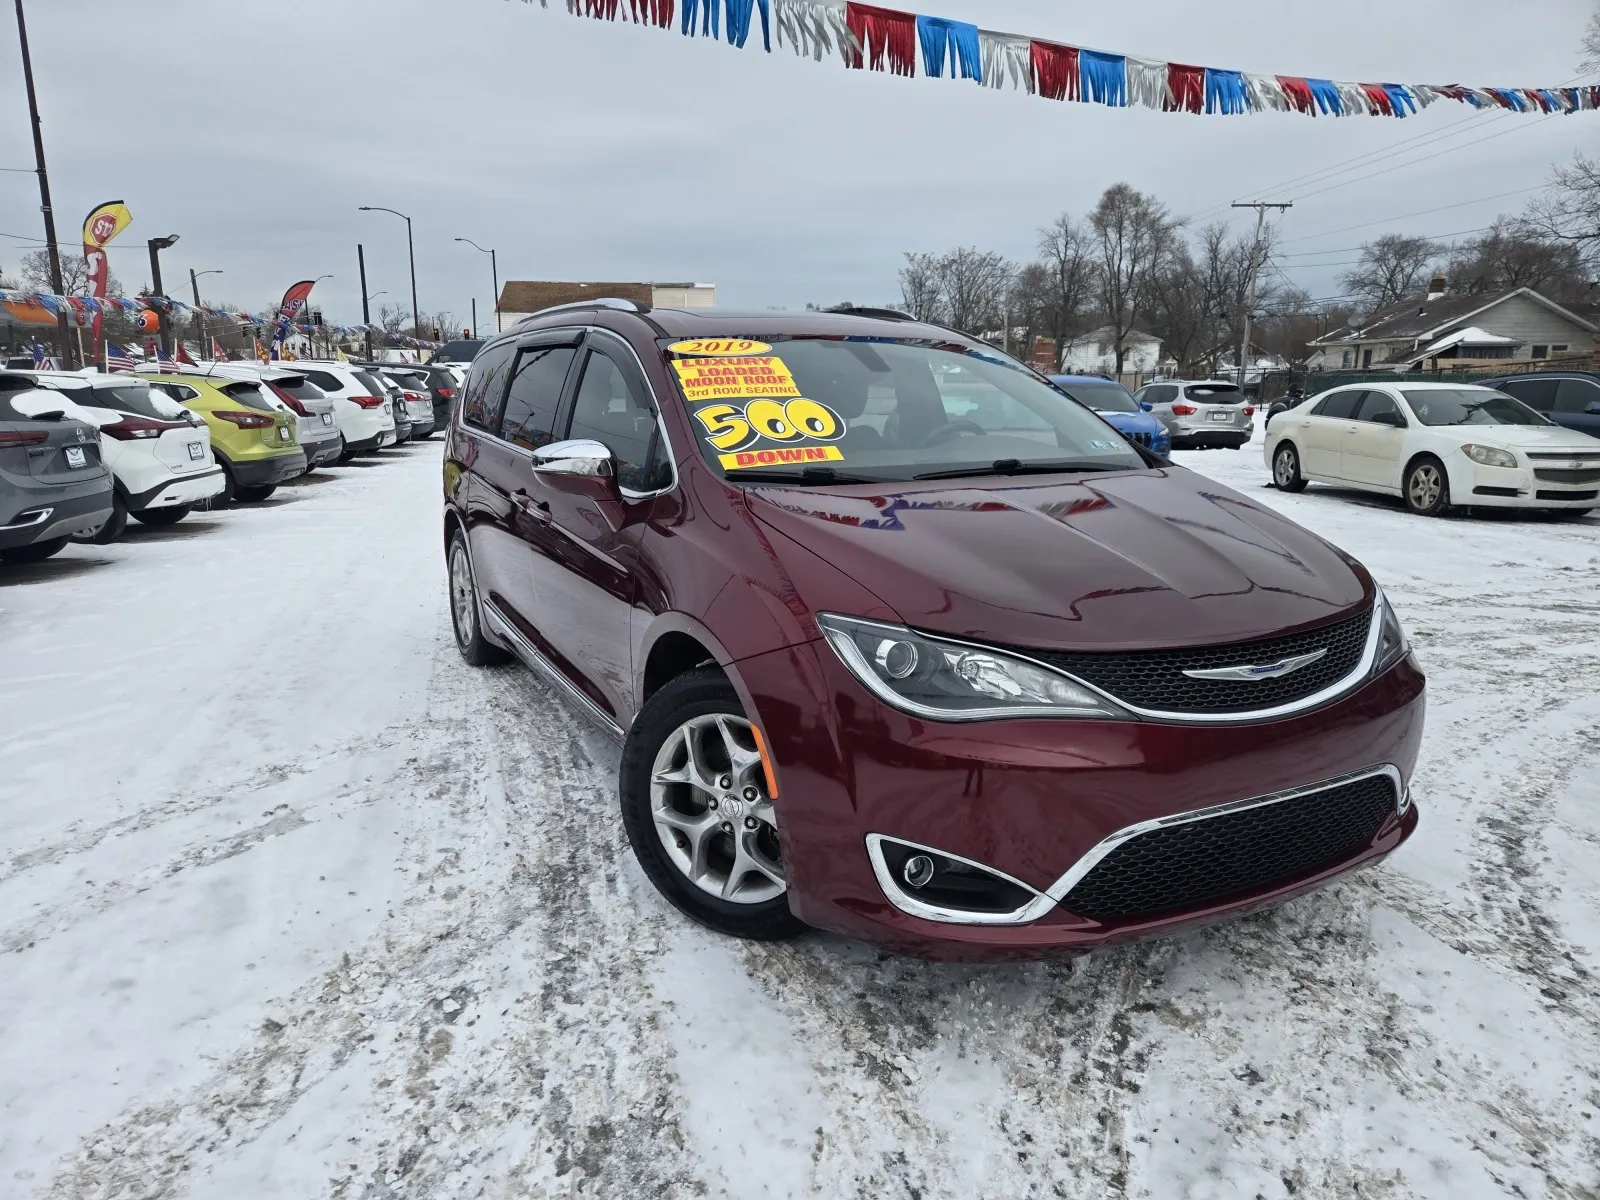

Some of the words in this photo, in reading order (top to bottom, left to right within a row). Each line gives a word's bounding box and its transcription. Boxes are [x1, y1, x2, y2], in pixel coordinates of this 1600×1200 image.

[688, 341, 753, 352] 2019
[681, 357, 774, 368] LUXURY
[697, 366, 776, 377] LOADED
[685, 376, 741, 388] MOON
[743, 375, 789, 386] ROOF
[688, 388, 709, 398] 3rd
[713, 386, 742, 396] ROW
[745, 386, 797, 394] SEATING
[694, 398, 847, 453] 500
[735, 448, 828, 466] DOWN
